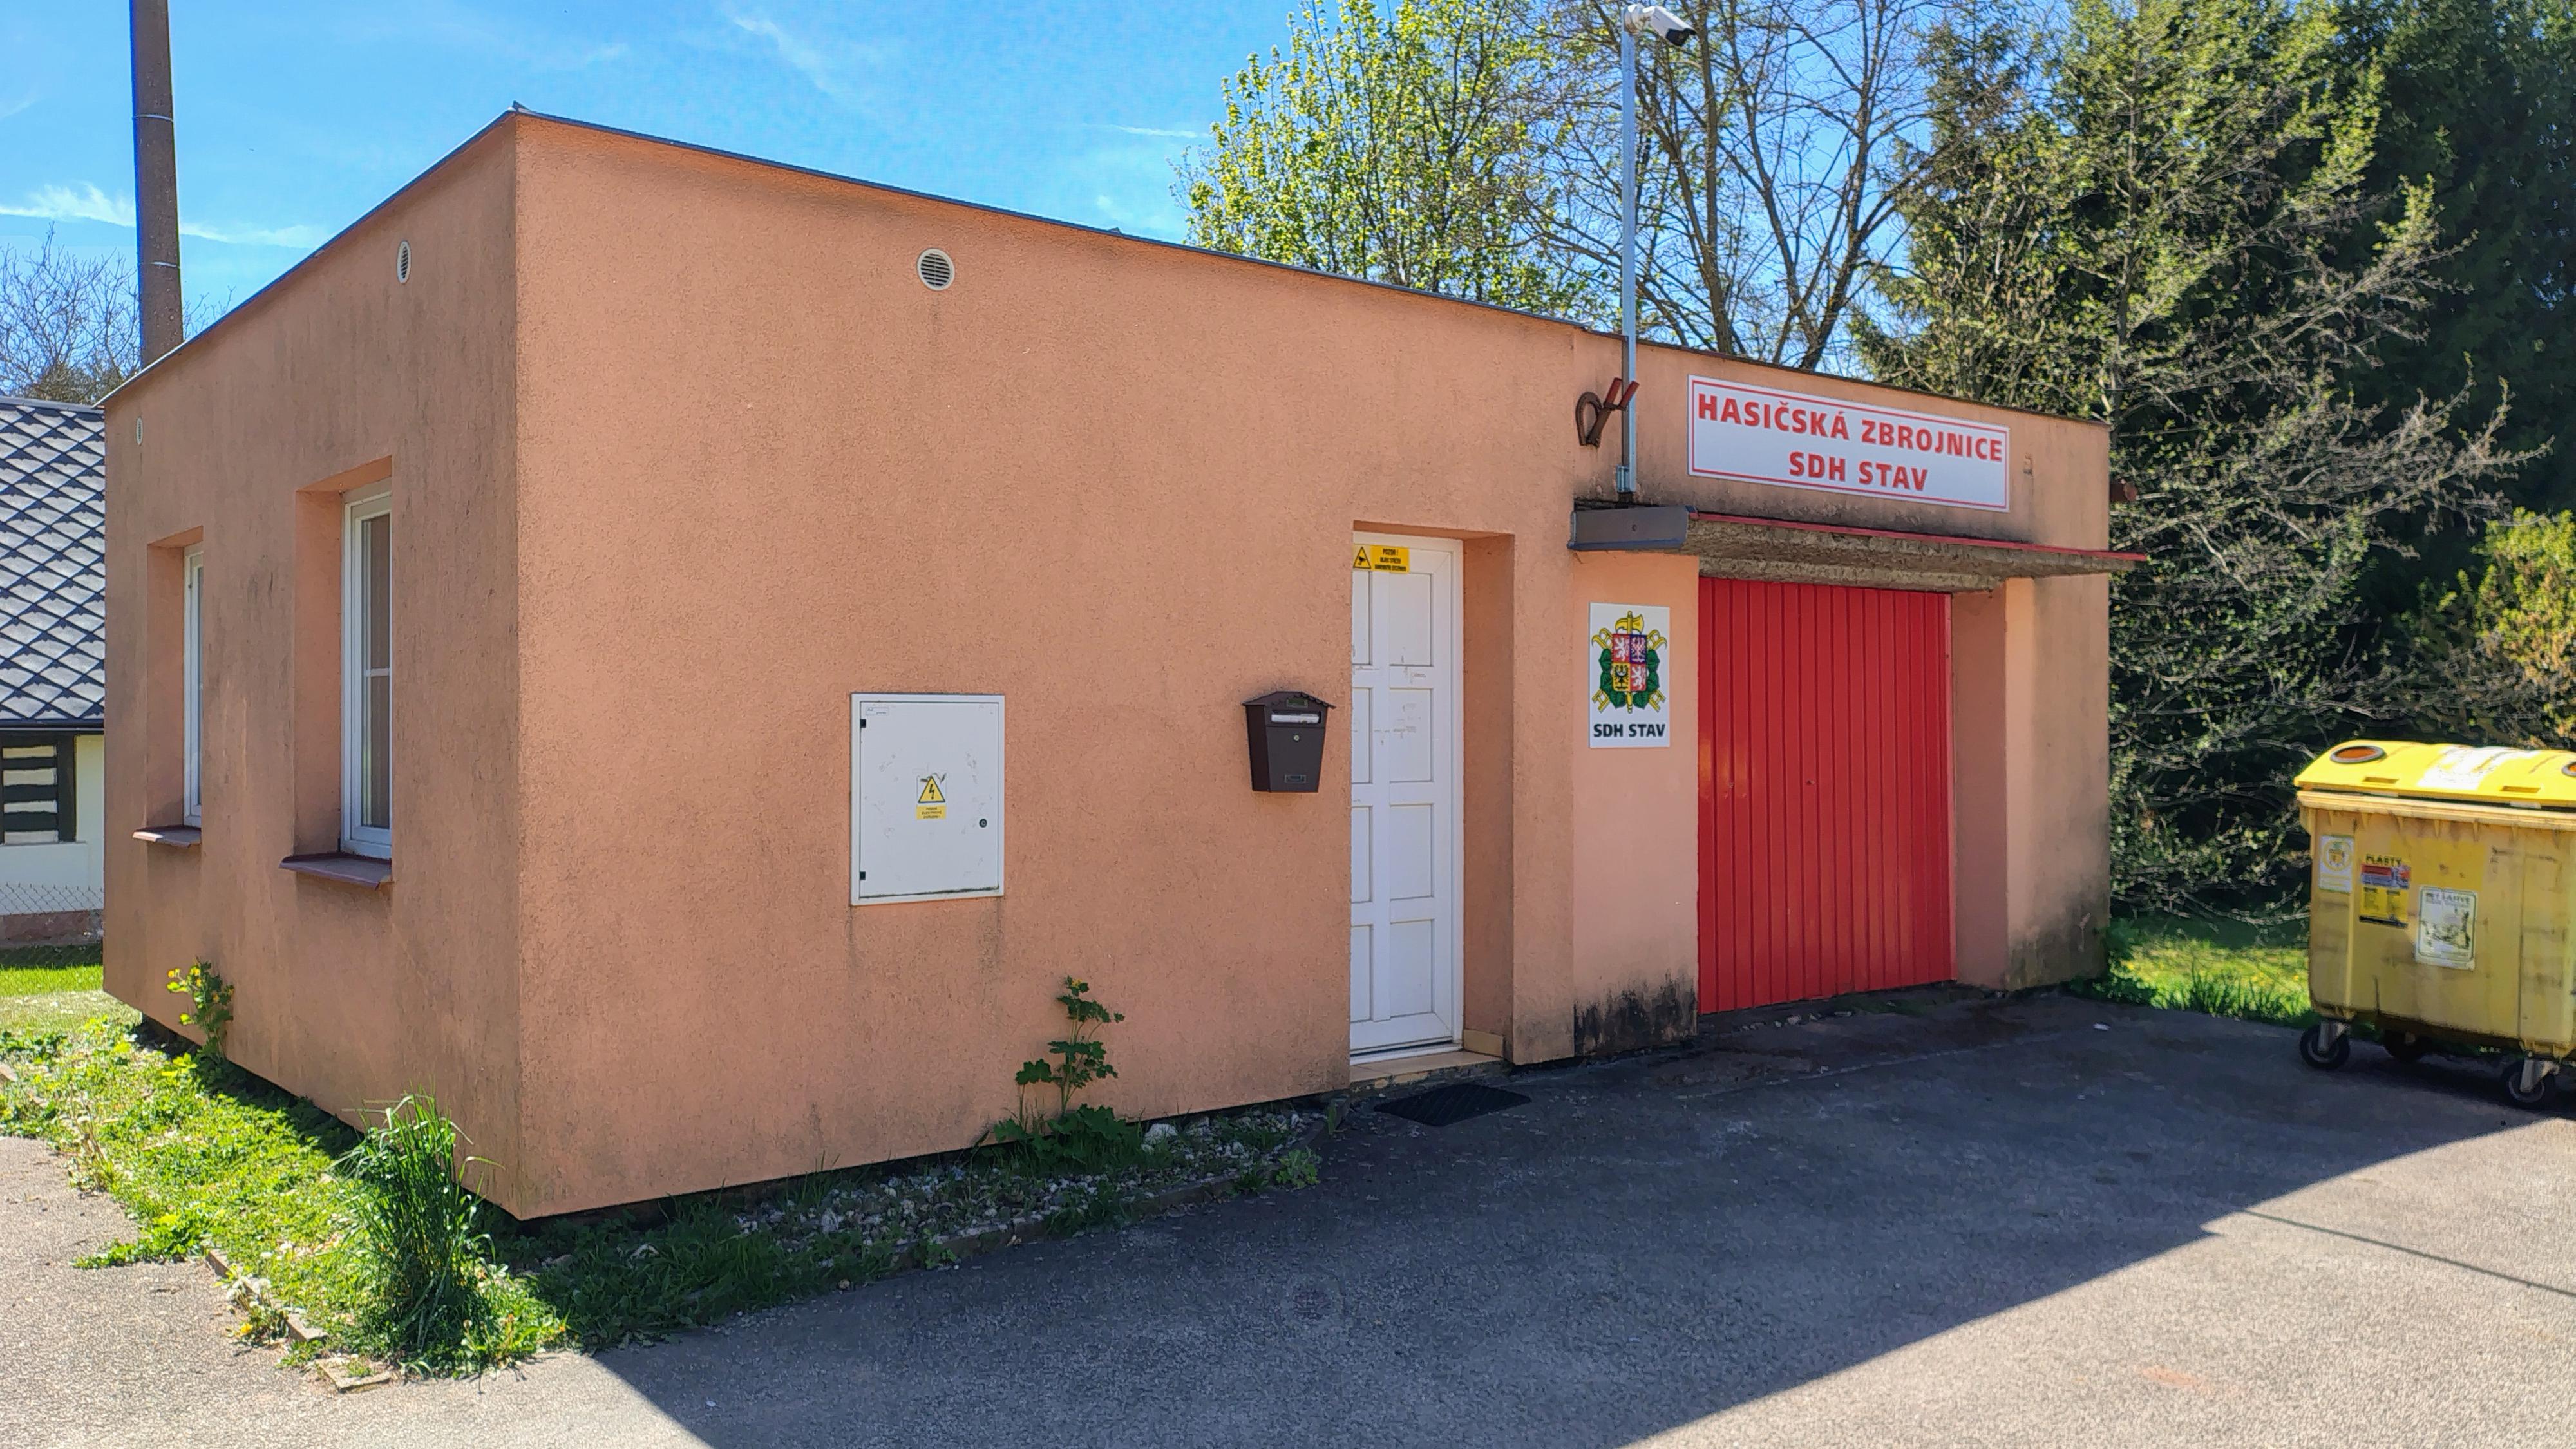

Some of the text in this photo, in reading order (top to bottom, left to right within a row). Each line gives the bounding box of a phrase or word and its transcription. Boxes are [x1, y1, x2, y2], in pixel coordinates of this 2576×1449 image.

[1698, 393, 2002, 462] HASIČSKÁ ZBROJNICE
[1789, 451, 1927, 491] SDH STAV
[1593, 723, 1666, 737] SDH STAV
